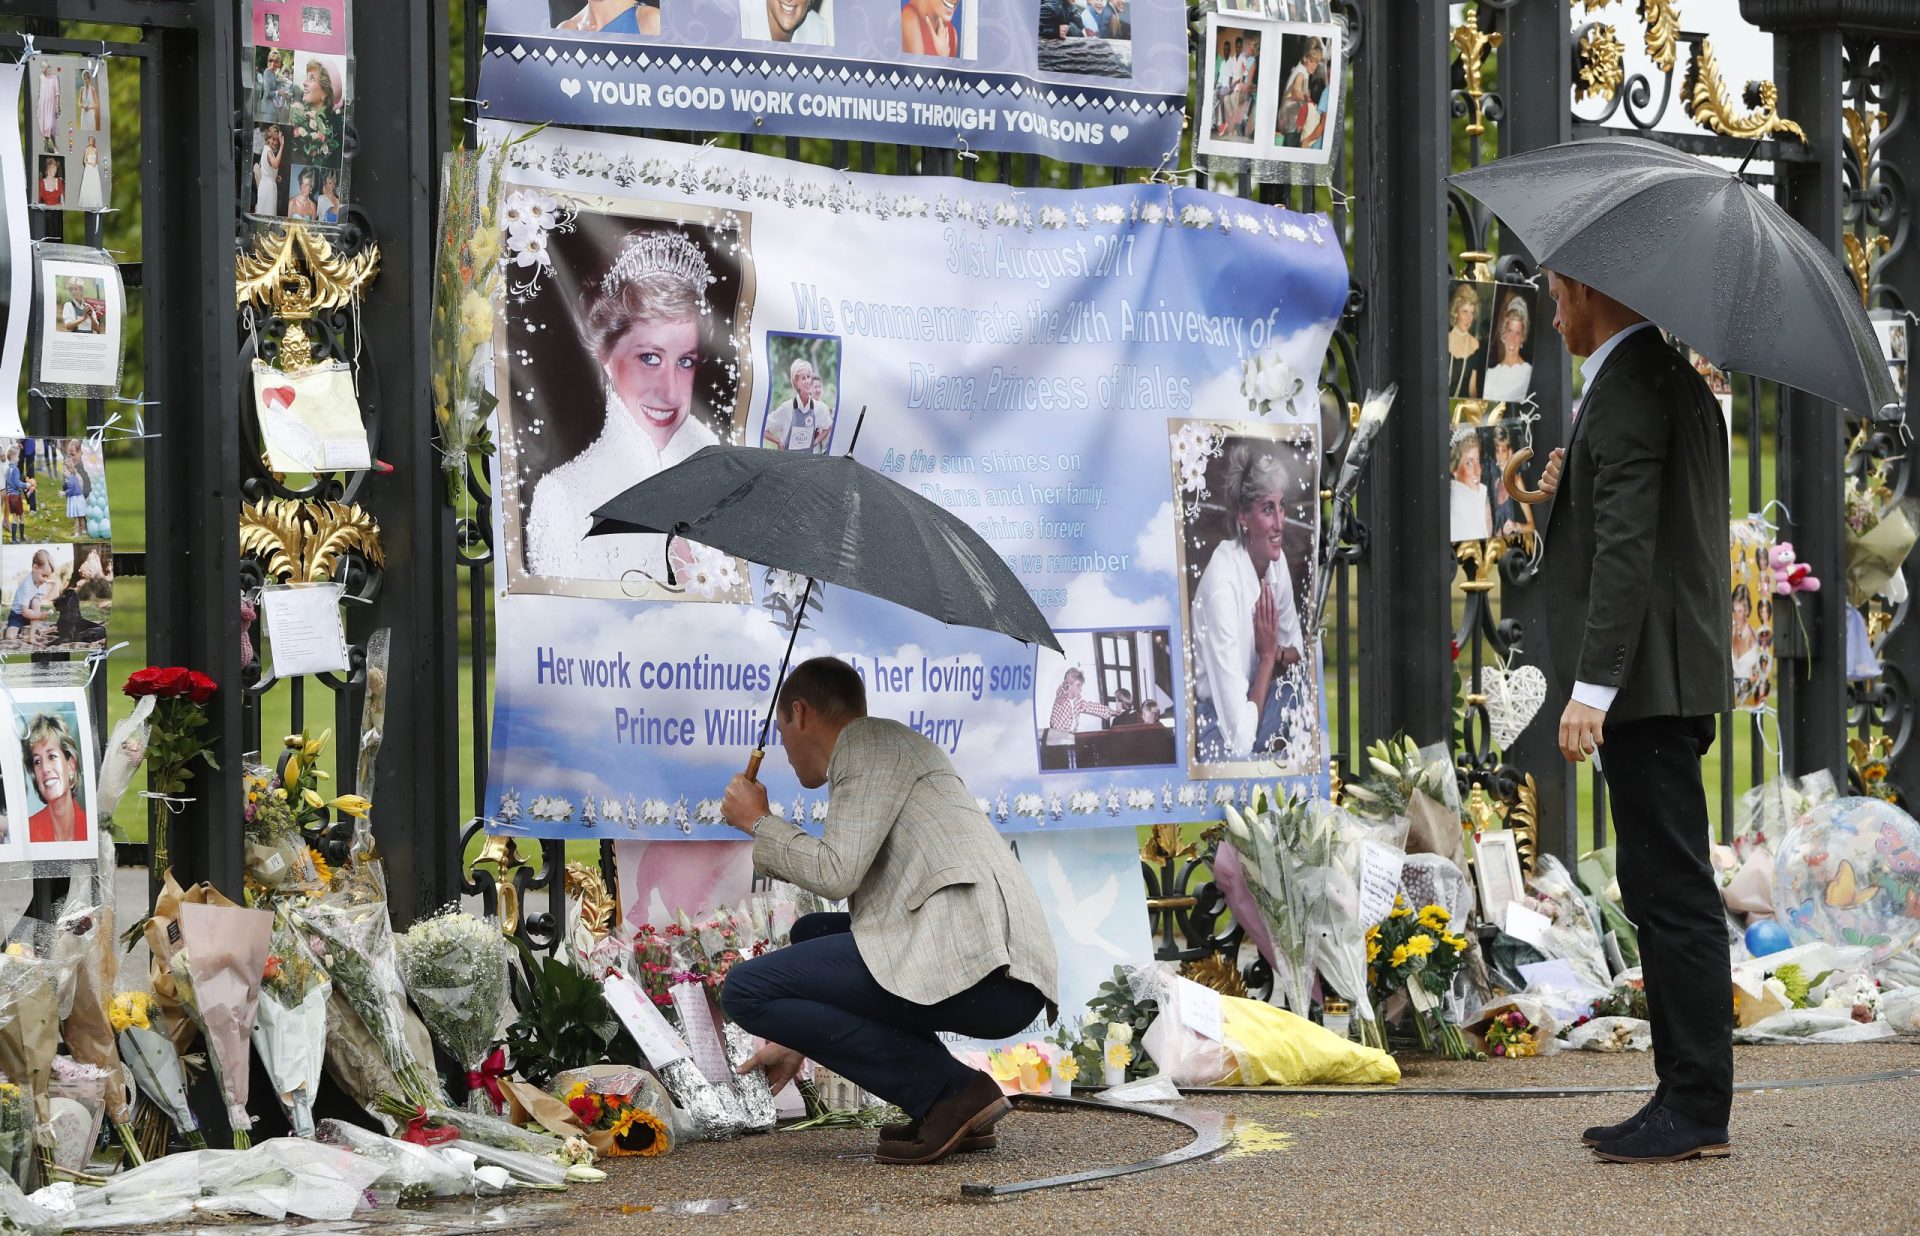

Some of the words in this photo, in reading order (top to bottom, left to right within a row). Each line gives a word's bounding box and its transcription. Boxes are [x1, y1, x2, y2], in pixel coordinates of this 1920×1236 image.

[587, 80, 652, 106] YOUR
[657, 84, 726, 111] GOOD
[731, 88, 795, 115] WORK
[798, 93, 908, 124] CONTINUES
[911, 102, 996, 131] THROUGH
[1002, 109, 1049, 138] YOUR
[1050, 118, 1105, 145] SONS
[944, 227, 990, 279] 31st
[995, 234, 1091, 290] August
[1093, 234, 1136, 278] 2017
[790, 282, 836, 333] We
[840, 299, 1023, 345] commemorate
[1026, 299, 1059, 345] the
[1058, 299, 1112, 344] 20th
[1250, 307, 1281, 350] of
[907, 361, 977, 420] Diana,
[982, 366, 1089, 412] Princess
[1096, 362, 1119, 410] of
[1119, 364, 1193, 410] Wales
[880, 448, 906, 473] As
[909, 449, 936, 474] the
[939, 453, 976, 474] sun
[980, 450, 1052, 474] shines
[1056, 452, 1082, 472] on
[920, 482, 981, 507] Diana
[985, 483, 1025, 507] and
[1028, 482, 1062, 505] her
[1065, 480, 1107, 511] family.
[977, 515, 1034, 539] shine
[1038, 514, 1087, 539] forever
[1022, 553, 1044, 573] we
[1046, 549, 1130, 574] remember
[537, 646, 574, 686] Her
[579, 651, 632, 689] work
[639, 653, 771, 692] continues
[874, 657, 914, 693] her
[922, 657, 984, 701] loving
[989, 664, 1033, 691] sons
[615, 707, 695, 746] Prince
[909, 710, 964, 754] Harry
